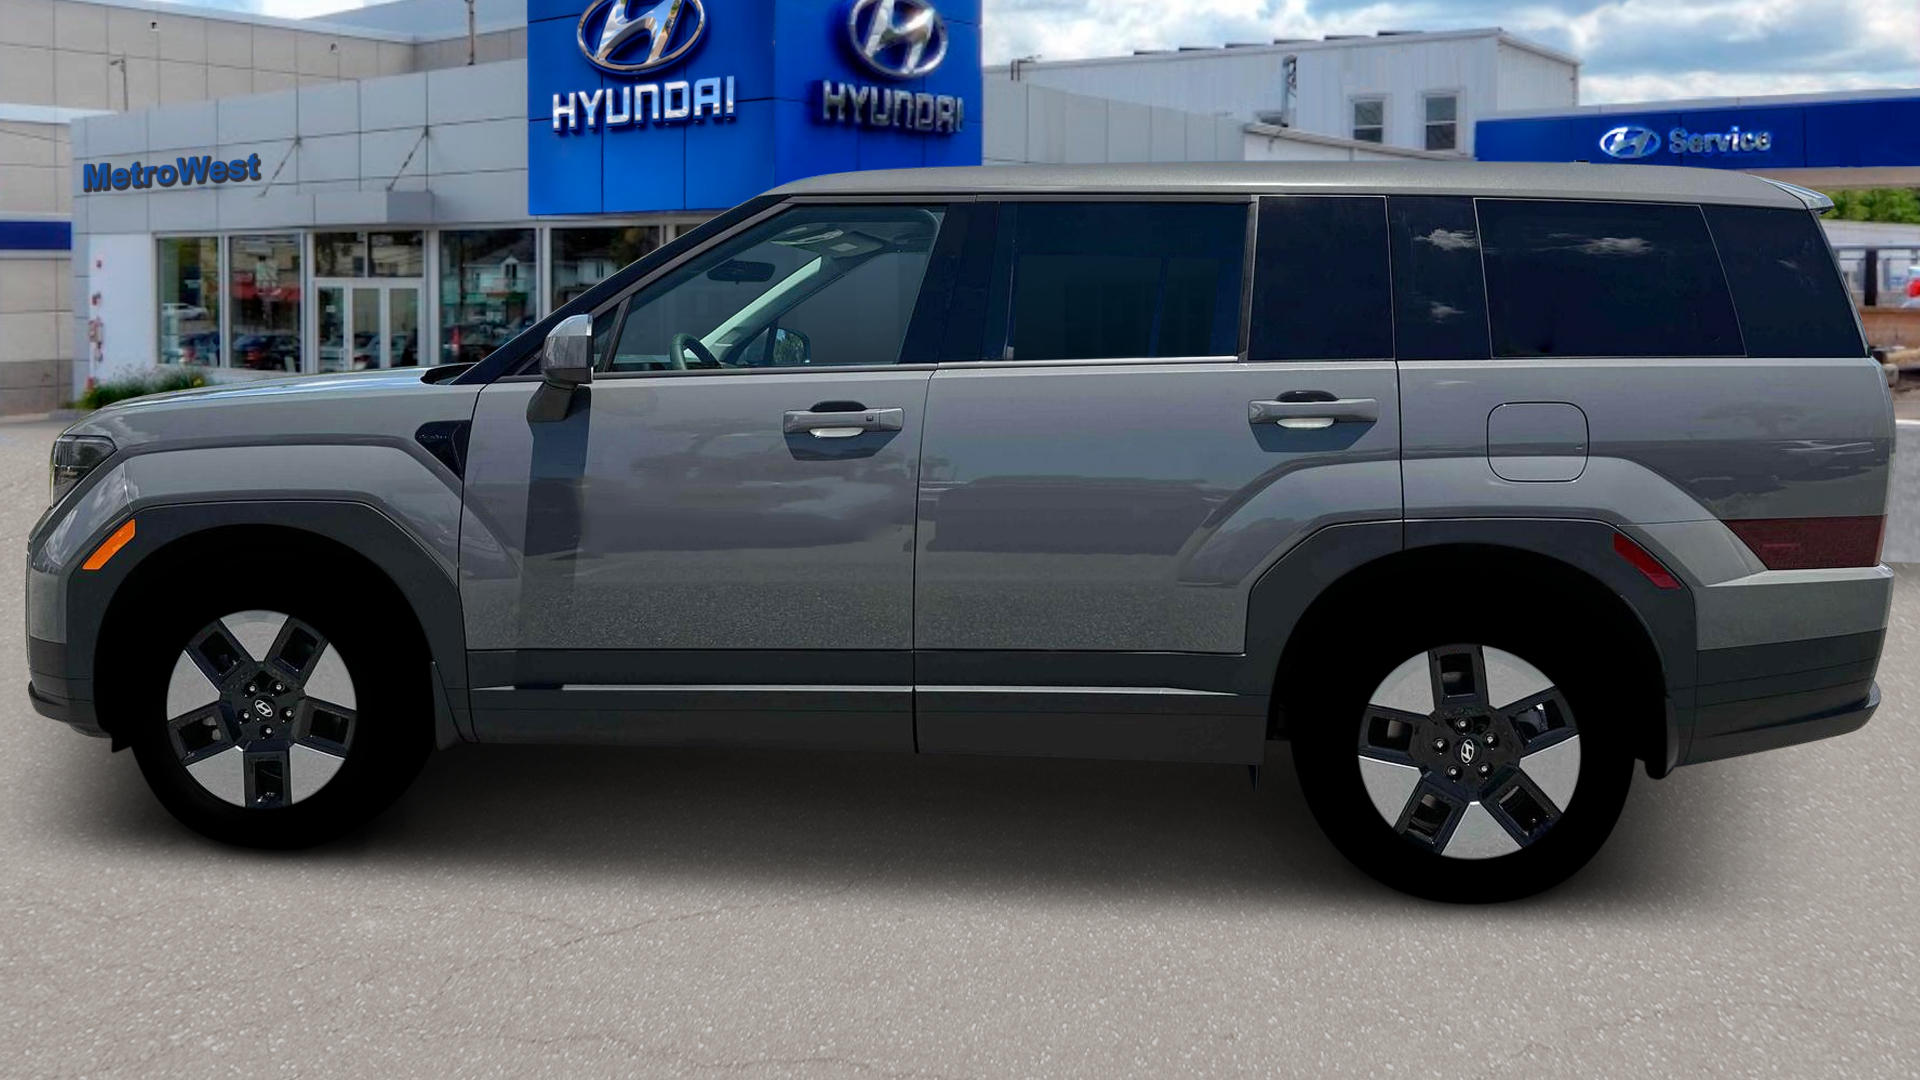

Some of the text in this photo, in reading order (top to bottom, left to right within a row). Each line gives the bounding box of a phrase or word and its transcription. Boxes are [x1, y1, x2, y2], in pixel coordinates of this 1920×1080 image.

[552, 75, 736, 132] HYUNDAI
[822, 79, 964, 133] HYUNDAI
[1669, 125, 1771, 153] Service
[83, 153, 262, 193] MetroWest
